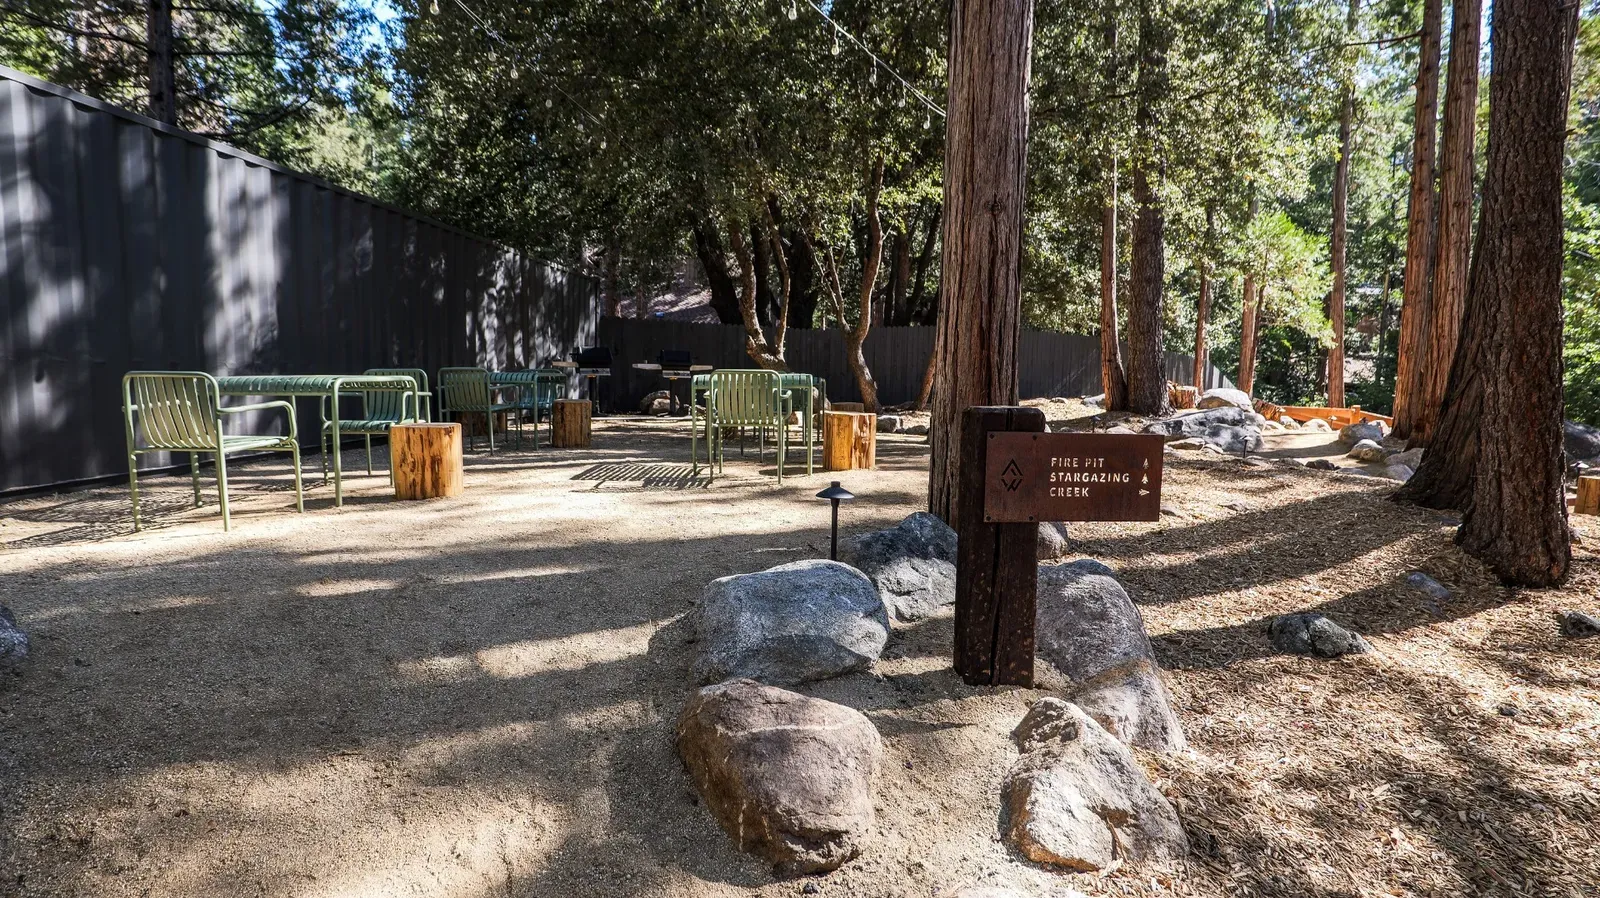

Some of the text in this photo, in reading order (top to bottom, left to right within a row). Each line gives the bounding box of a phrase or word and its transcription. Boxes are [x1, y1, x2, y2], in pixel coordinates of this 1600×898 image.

[1051, 457, 1105, 468] FIRE PIT
[1049, 472, 1130, 483] STARGAZING
[1049, 487, 1089, 497] CREEK
